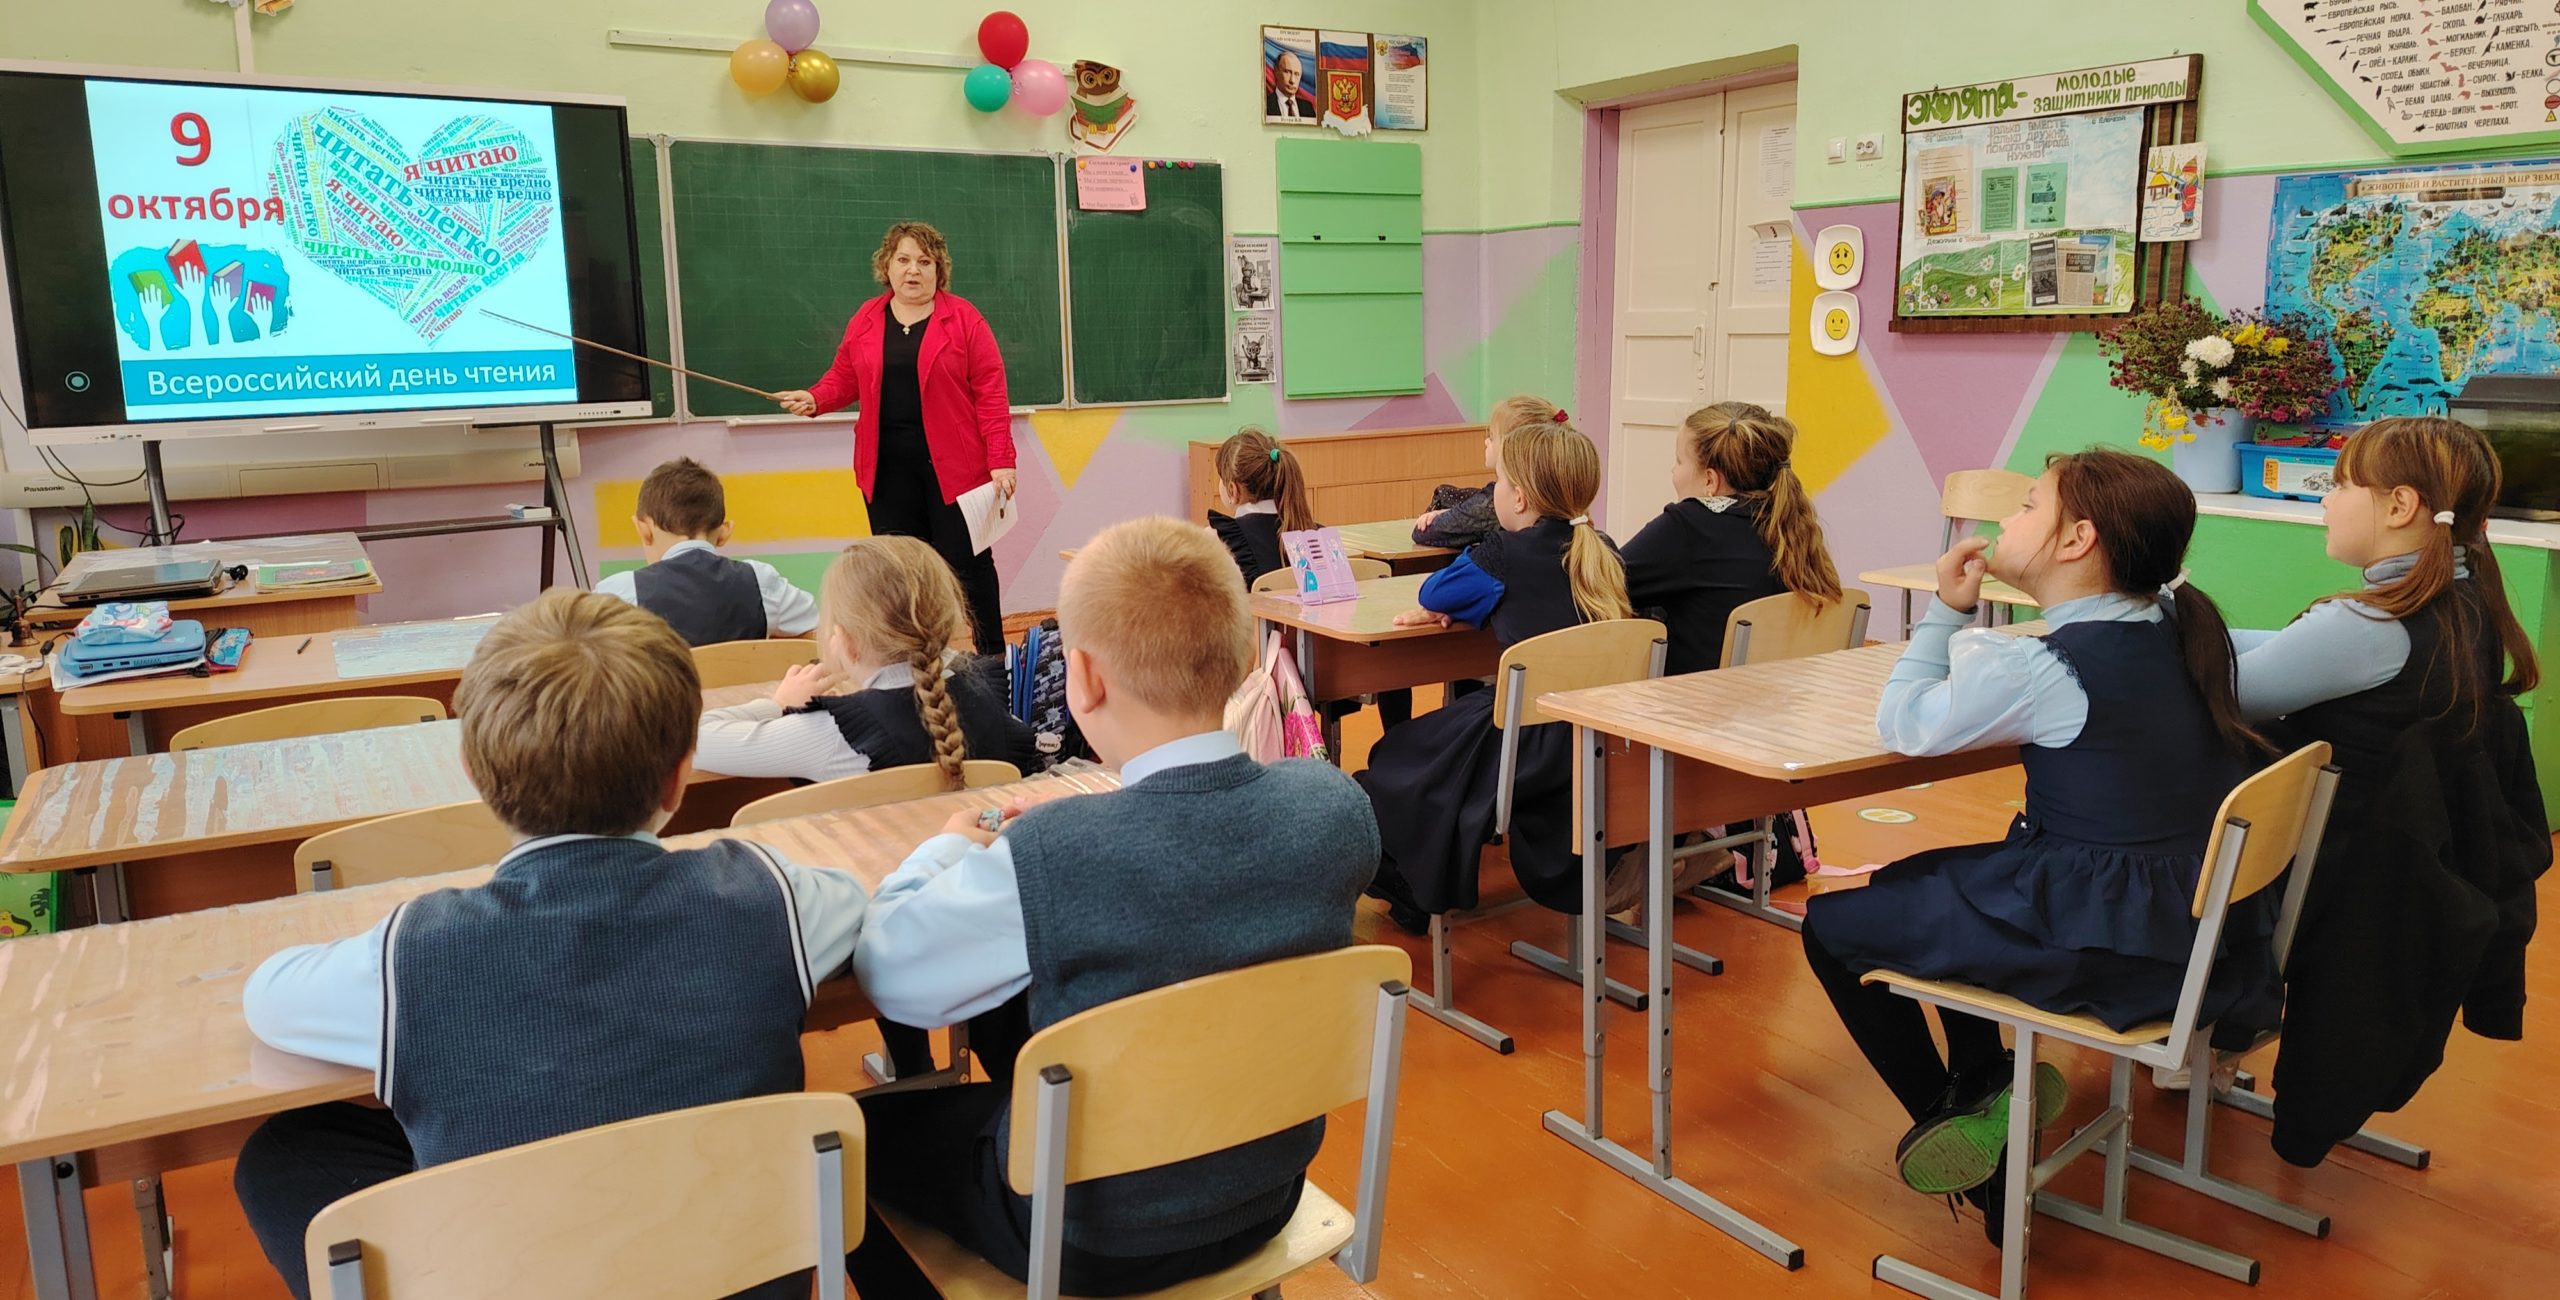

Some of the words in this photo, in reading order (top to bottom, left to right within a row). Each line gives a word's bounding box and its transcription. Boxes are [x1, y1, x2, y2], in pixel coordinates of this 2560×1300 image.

[2328, 5, 2375, 20] ЕВРОПЕЙСКАЯ
[2380, 2, 2400, 11] РЫСЬ.
[2339, 16, 2385, 31] ЕВРОПЕЙСКАЯ
[2390, 12, 2415, 24] НОРКА.
[2356, 31, 2381, 42] РЕЧНАЯ
[2358, 43, 2382, 56] СЕРЫЙ
[2380, 71, 2404, 81] ОСОЕД
[2391, 83, 2415, 94] ФИЛИН
[2405, 94, 2426, 106] БЕЛАЯ
[170, 111, 212, 167] 9
[327, 108, 366, 142] читать
[366, 140, 401, 166] легко
[2435, 121, 2468, 132] БОЛОТНАЯ
[441, 141, 477, 156] время
[479, 133, 519, 147] читать
[403, 163, 422, 182] я
[426, 145, 518, 177] читаю
[292, 131, 309, 188] читать
[301, 190, 318, 237] легко
[314, 123, 416, 206] читать
[417, 203, 501, 267] легко
[414, 187, 471, 199] читать
[474, 188, 494, 199] не
[497, 189, 552, 203] вредно
[423, 175, 477, 186] читать
[480, 177, 497, 187] не
[500, 178, 552, 190] вредно
[2367, 181, 2420, 192] ЖИВОТНЫЙ
[2423, 180, 2430, 189] И
[2432, 176, 2507, 188] РАСТИТЕЛЬНЫЙ
[2508, 174, 2530, 184] МИР
[107, 187, 285, 229] октября
[325, 178, 342, 194] я
[345, 190, 404, 247] читаю
[329, 160, 378, 205] время
[379, 201, 427, 250] читать
[326, 190, 362, 225] читать
[362, 224, 395, 252] легко
[451, 210, 482, 237] читаю
[407, 210, 442, 240] читать
[444, 237, 473, 261] везде
[304, 240, 374, 260] читать
[390, 253, 422, 267] это
[426, 256, 487, 276] модно
[316, 258, 345, 266] читать
[360, 259, 387, 267] вредно
[334, 266, 375, 276] читать
[380, 267, 392, 276] не
[393, 267, 432, 278] вредно
[434, 283, 483, 319] читать
[481, 252, 526, 287] всегда
[410, 297, 443, 326] читать
[441, 275, 469, 300] везде
[434, 308, 464, 333] читаю
[147, 363, 381, 400] Всероссийский
[388, 365, 458, 392] день
[464, 363, 556, 385] чтения
[23, 485, 66, 493] Panasonic
